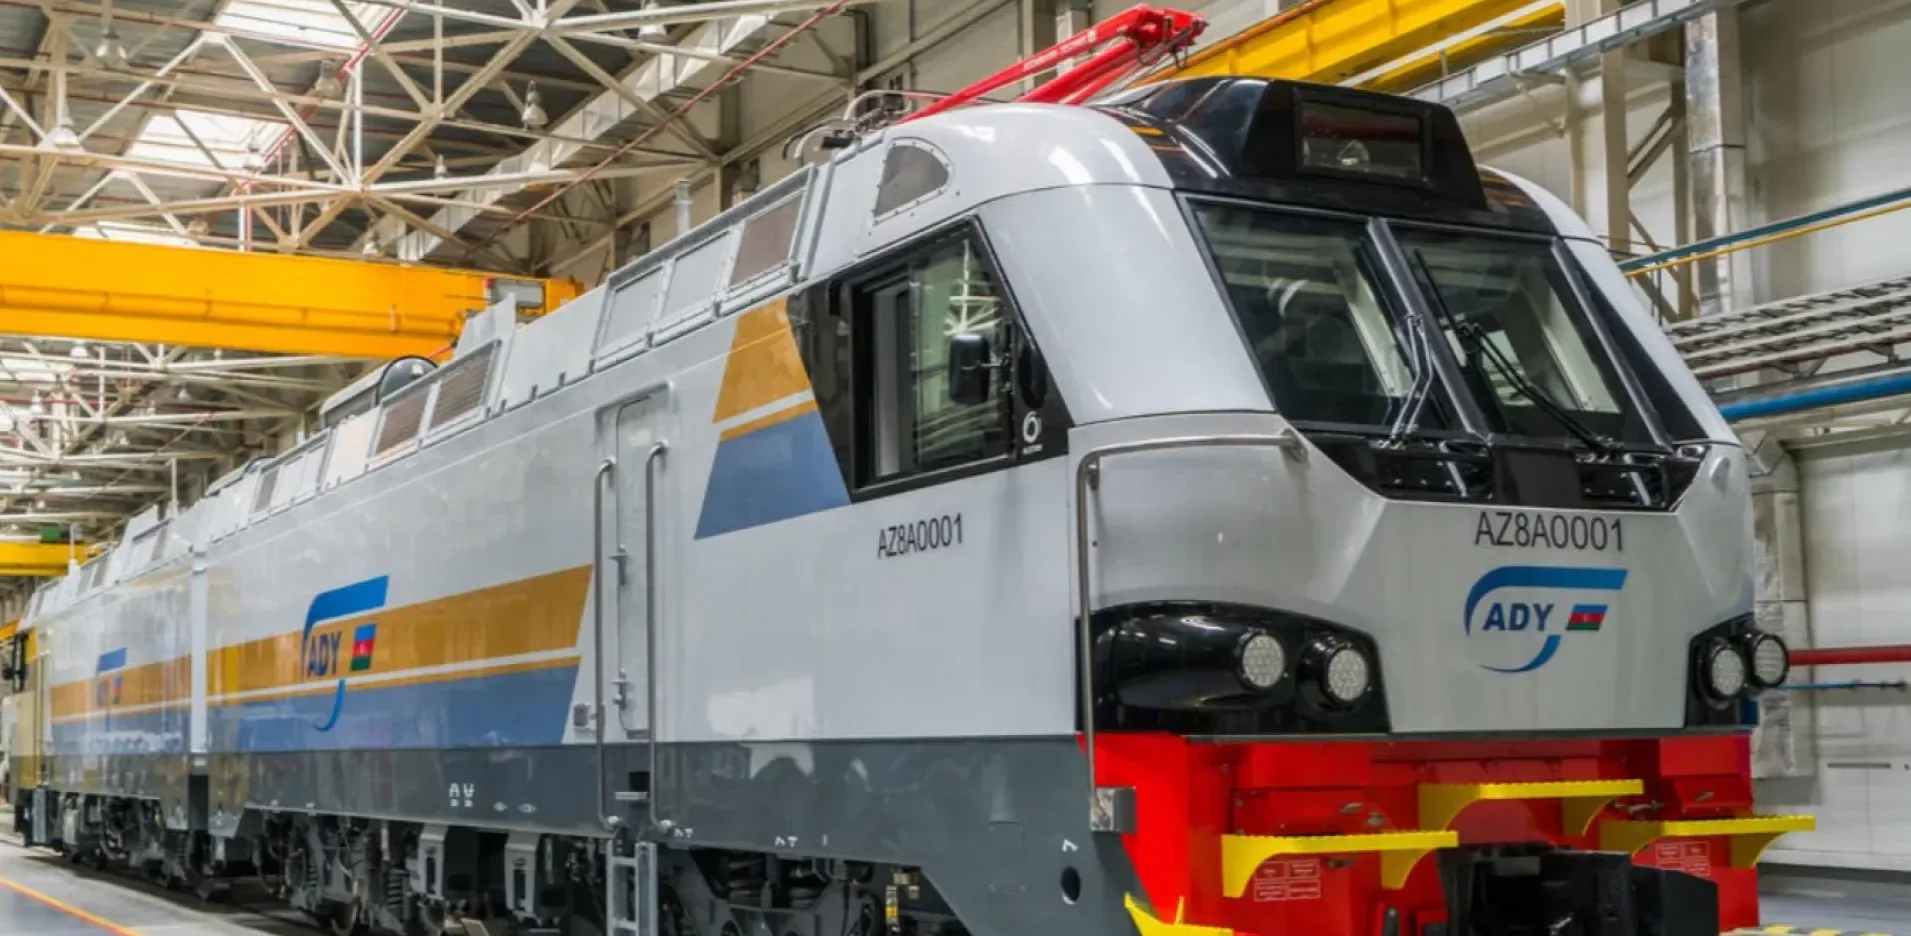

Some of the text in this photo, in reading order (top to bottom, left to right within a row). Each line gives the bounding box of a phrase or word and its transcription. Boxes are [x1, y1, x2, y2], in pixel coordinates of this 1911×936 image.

[878, 512, 962, 558] AZ8A0001
[1475, 511, 1622, 551] AZ8A0001
[1483, 603, 1554, 631] ADY
[307, 630, 342, 677] ADY
